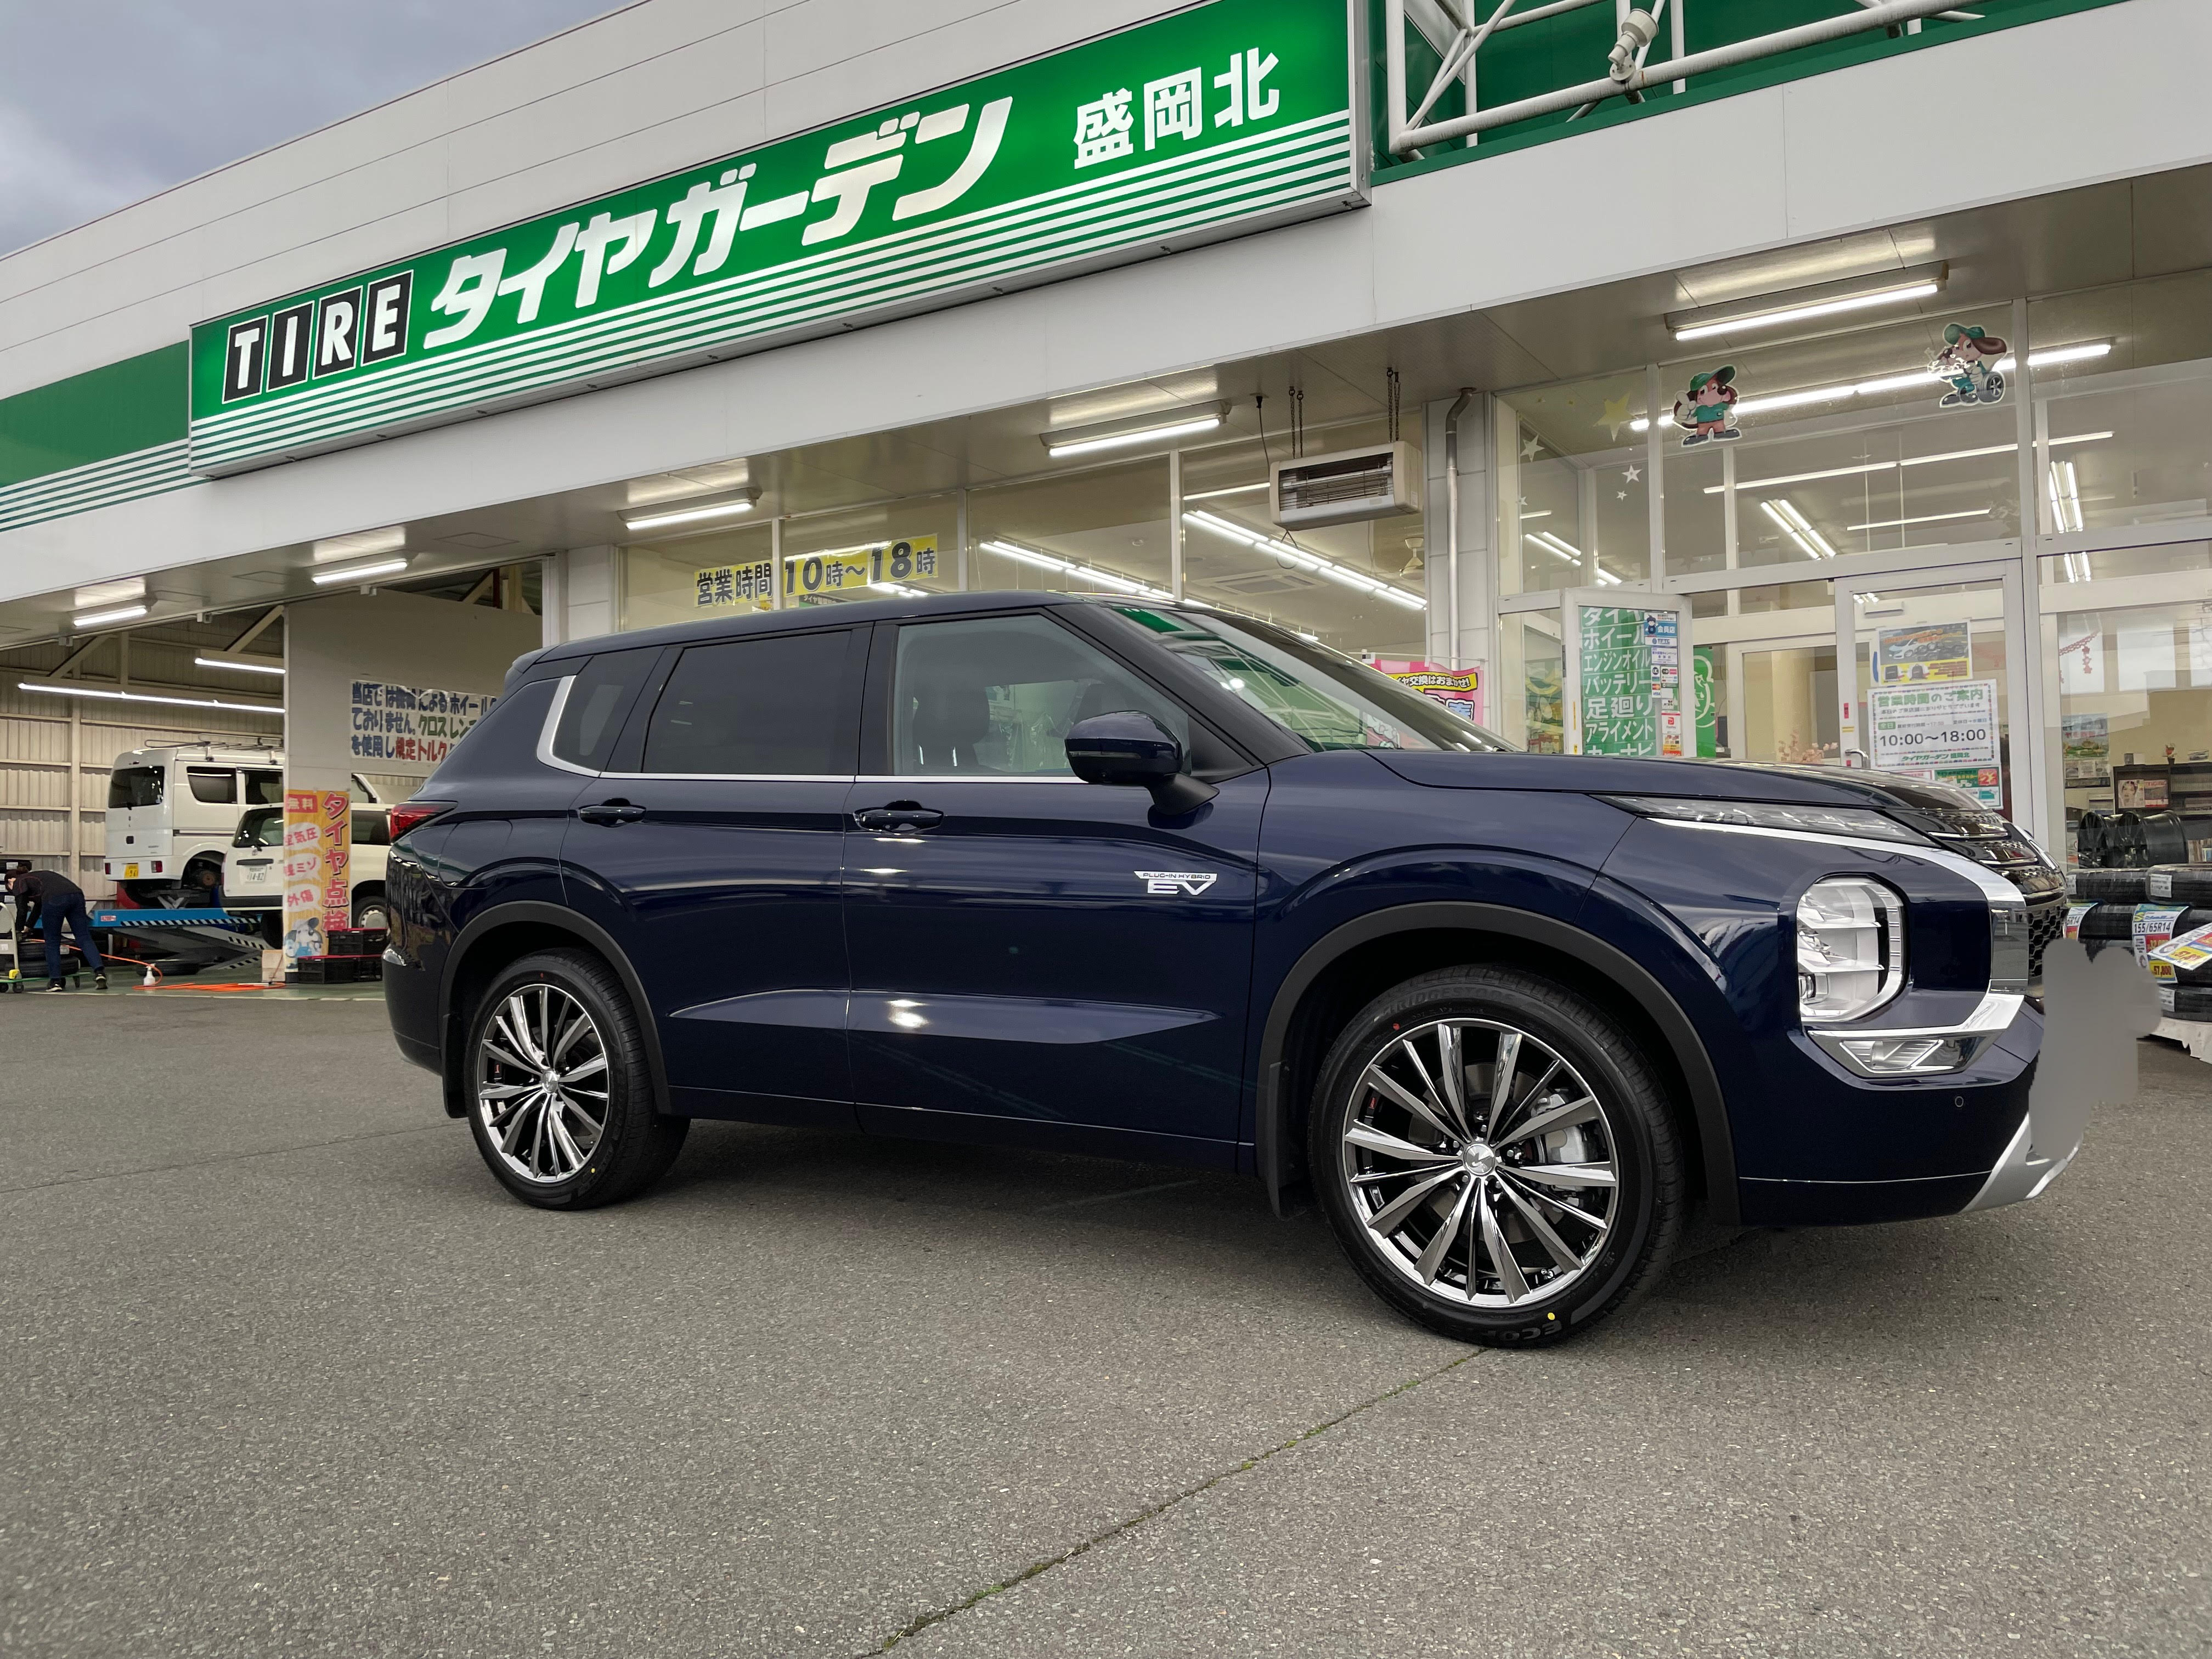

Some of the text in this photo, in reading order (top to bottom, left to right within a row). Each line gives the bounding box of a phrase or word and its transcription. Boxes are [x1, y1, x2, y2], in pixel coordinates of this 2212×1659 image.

[234, 47, 1280, 390] TIRE タイヤガーデン 盛岡北
[697, 563, 772, 606] 営業時間
[1584, 649, 1651, 672] エンジンオイル
[1585, 672, 1651, 695] バッテリー
[1586, 694, 1653, 720] 足廻り
[1585, 718, 1653, 743] アライメント
[1147, 879, 1215, 895] EV
[2134, 922, 2171, 933] 155/65R14
